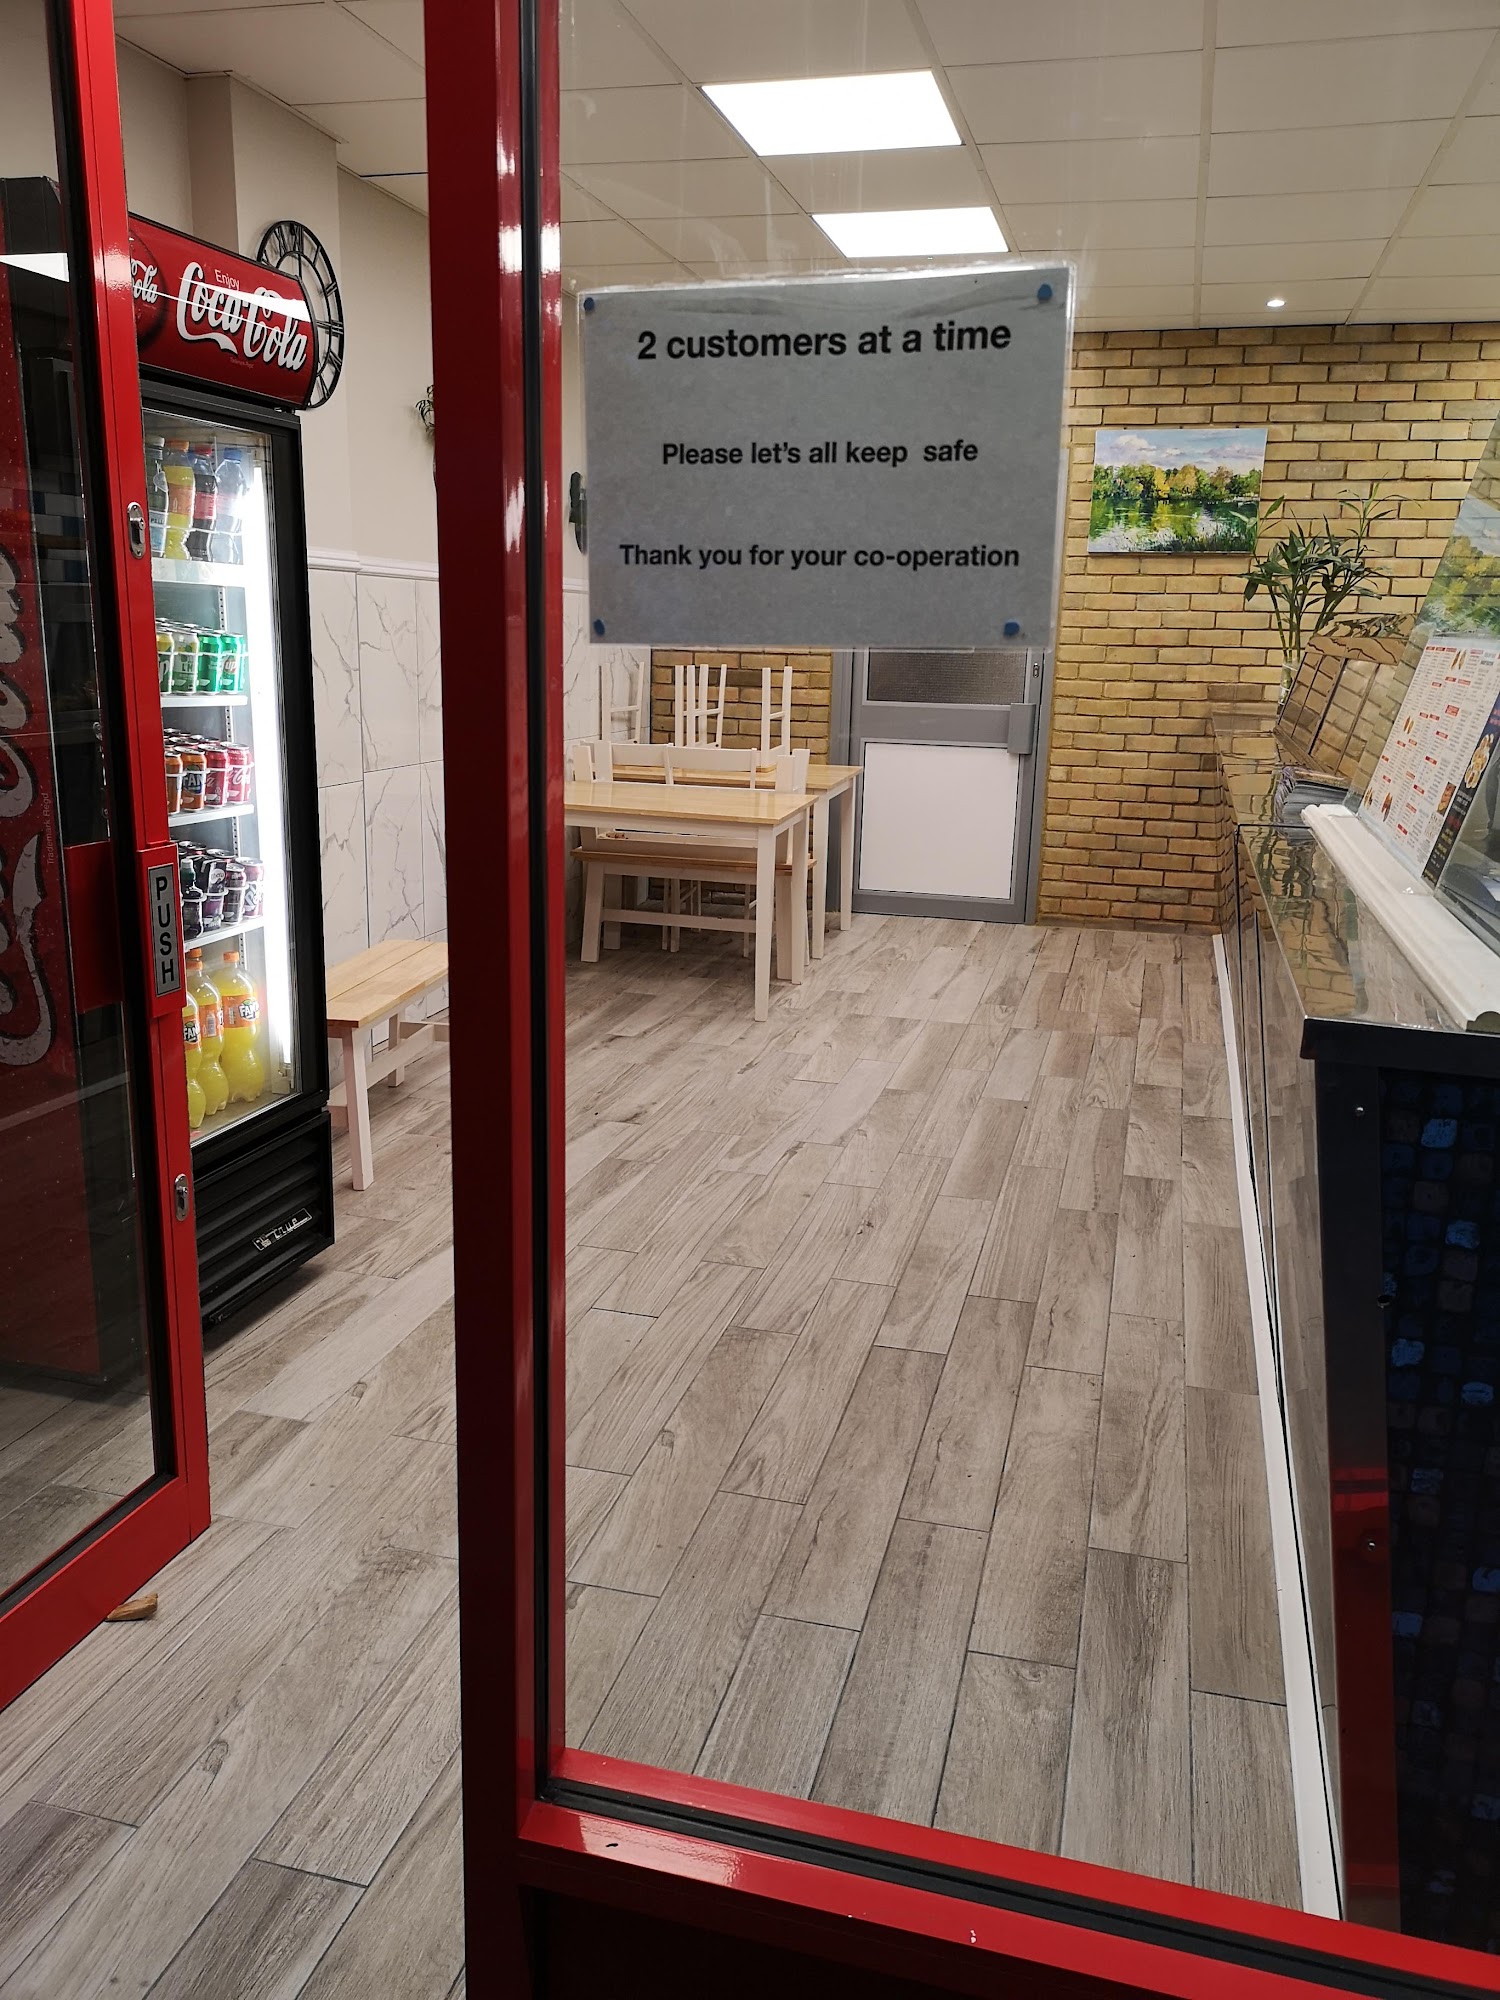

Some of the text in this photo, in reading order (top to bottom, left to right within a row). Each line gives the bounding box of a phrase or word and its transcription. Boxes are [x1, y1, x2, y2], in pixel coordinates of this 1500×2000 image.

[214, 269, 240, 291] Enjoy
[637, 320, 1012, 360] 2 customers at a time
[662, 442, 744, 466] Please
[808, 441, 838, 464] all
[845, 440, 908, 468] keep
[923, 438, 979, 463] safe
[618, 543, 1020, 572] Thank you for your co-operation
[42, 792, 55, 865] Trademark Regd
[156, 876, 174, 984] PUSH
